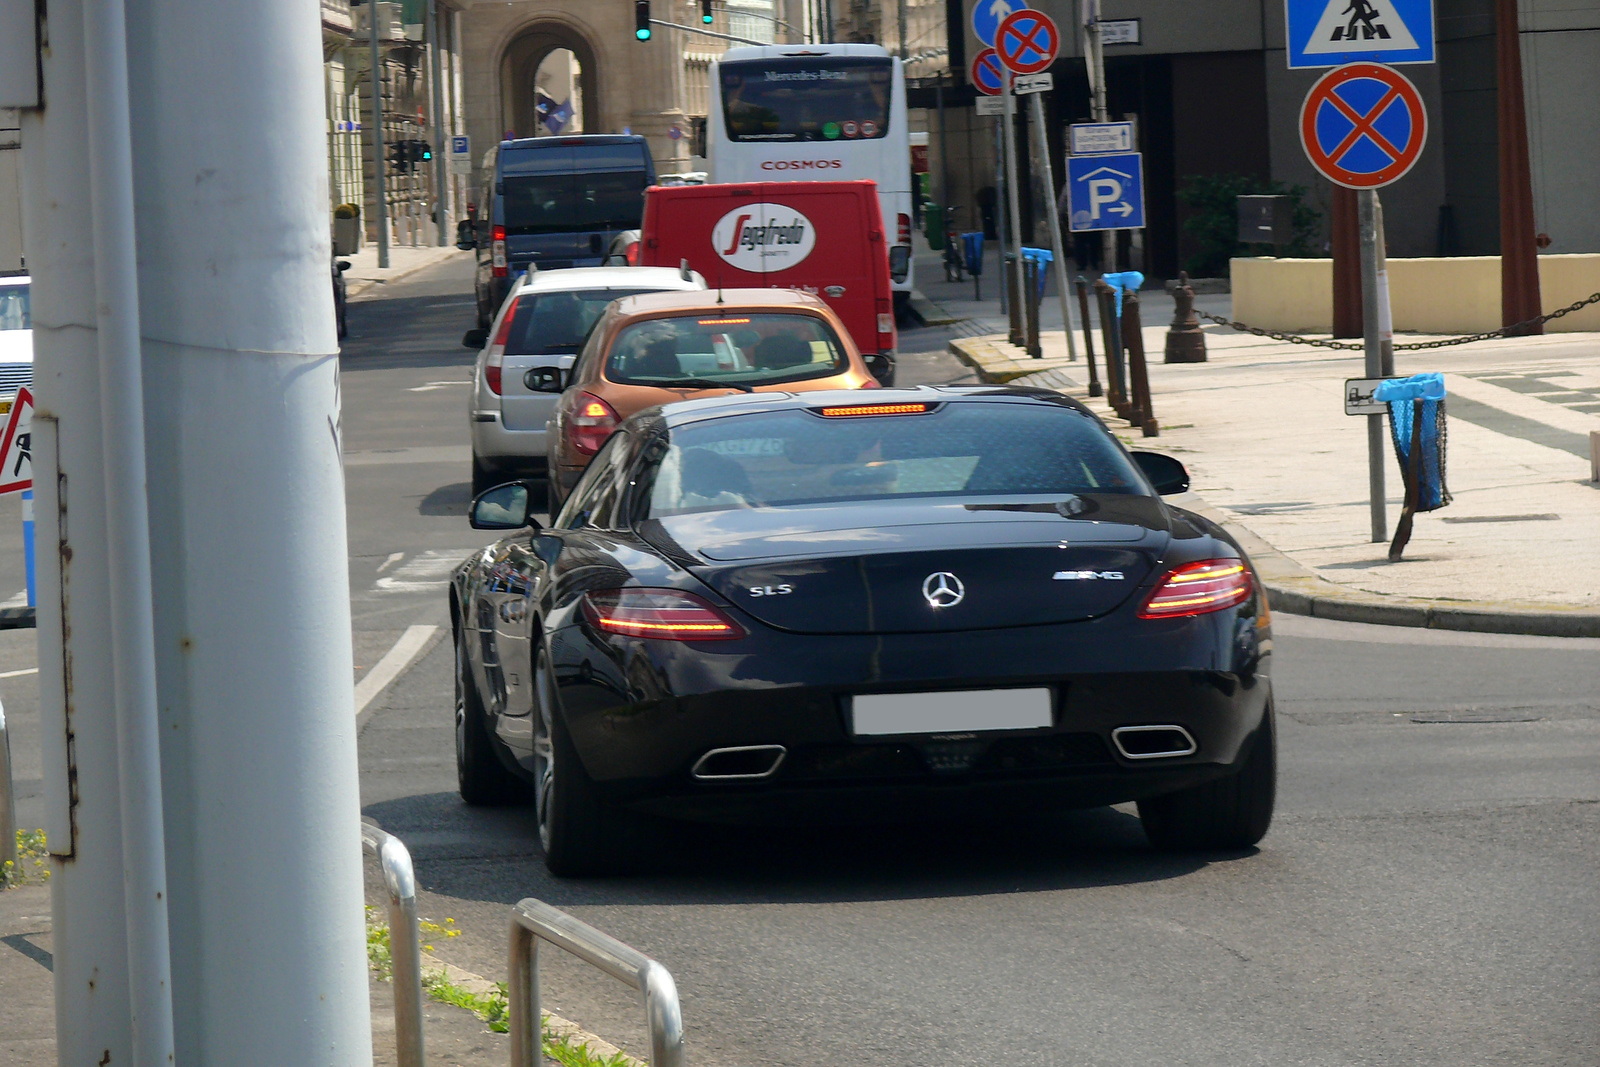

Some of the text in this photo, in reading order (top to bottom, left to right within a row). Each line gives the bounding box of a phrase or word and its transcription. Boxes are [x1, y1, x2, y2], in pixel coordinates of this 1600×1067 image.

[764, 70, 848, 82] Mercedes-Benz
[761, 159, 842, 170] COSMOS
[1088, 178, 1122, 220] P
[723, 214, 805, 256] Segafredo
[749, 583, 793, 598] SLS
